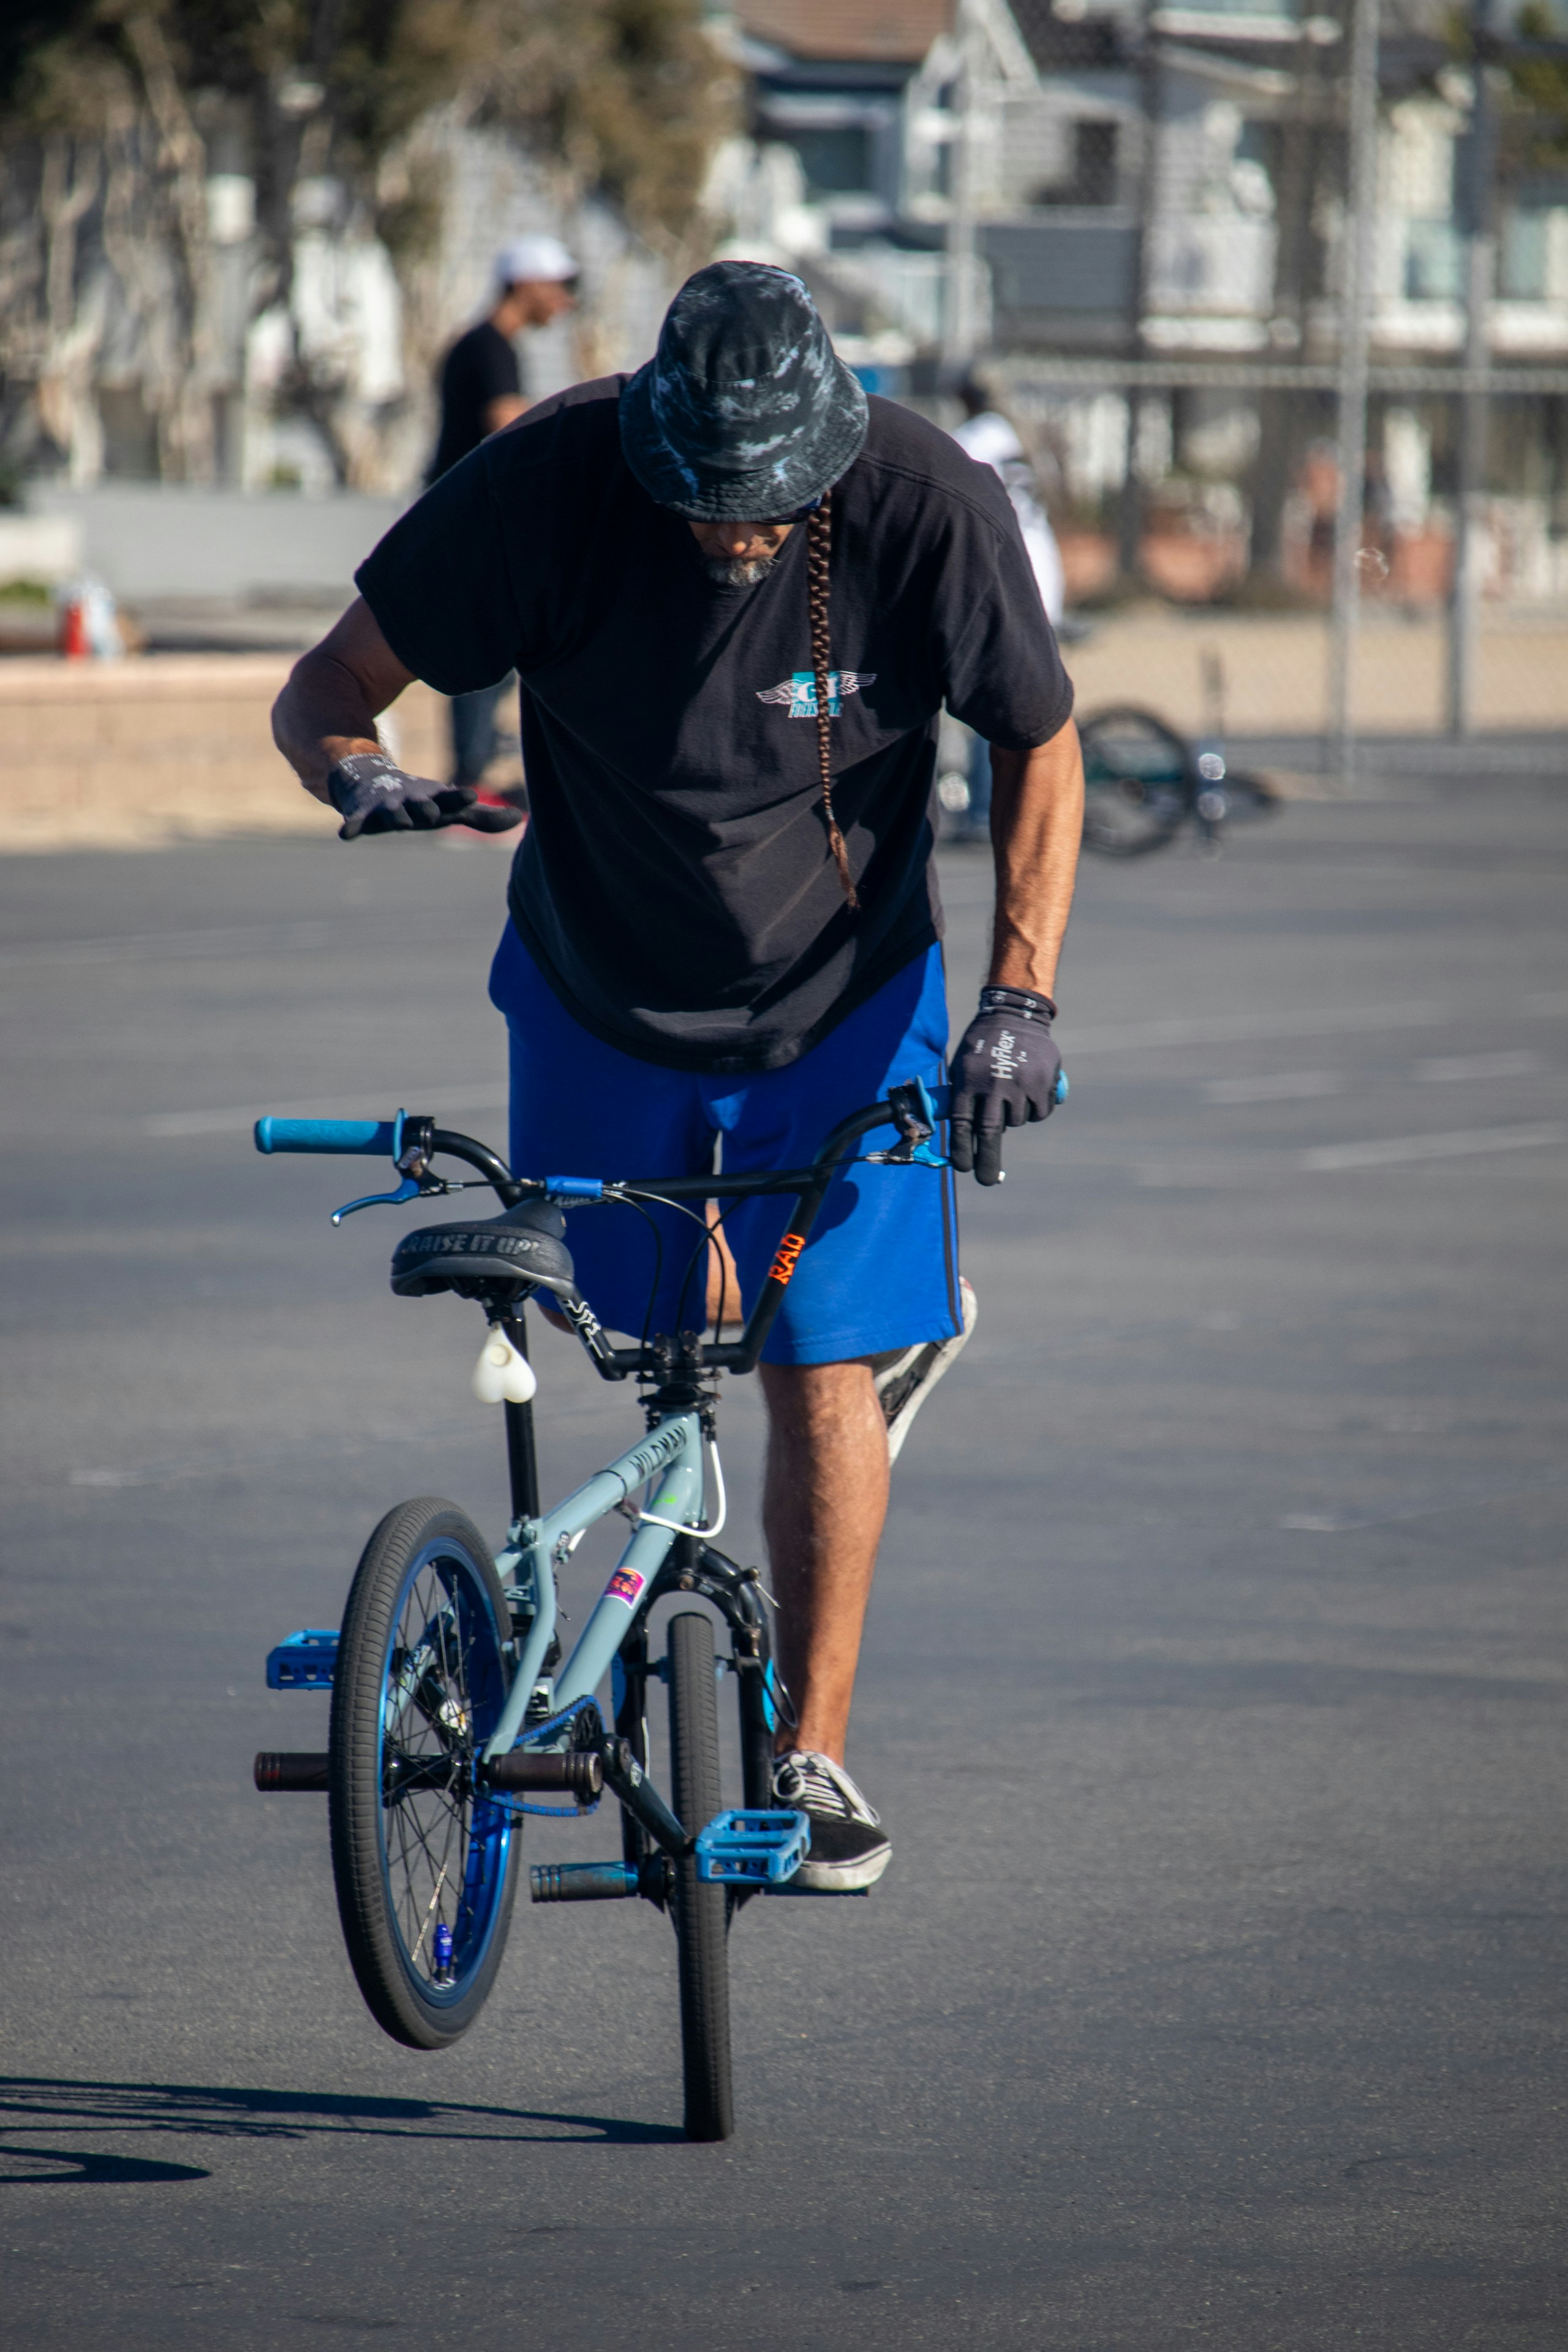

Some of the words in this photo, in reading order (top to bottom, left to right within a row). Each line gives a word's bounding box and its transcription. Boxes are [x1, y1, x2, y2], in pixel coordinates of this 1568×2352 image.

[405, 1234, 467, 1253] RAISE
[470, 1235, 494, 1252] IT
[768, 1233, 805, 1285] RAD
